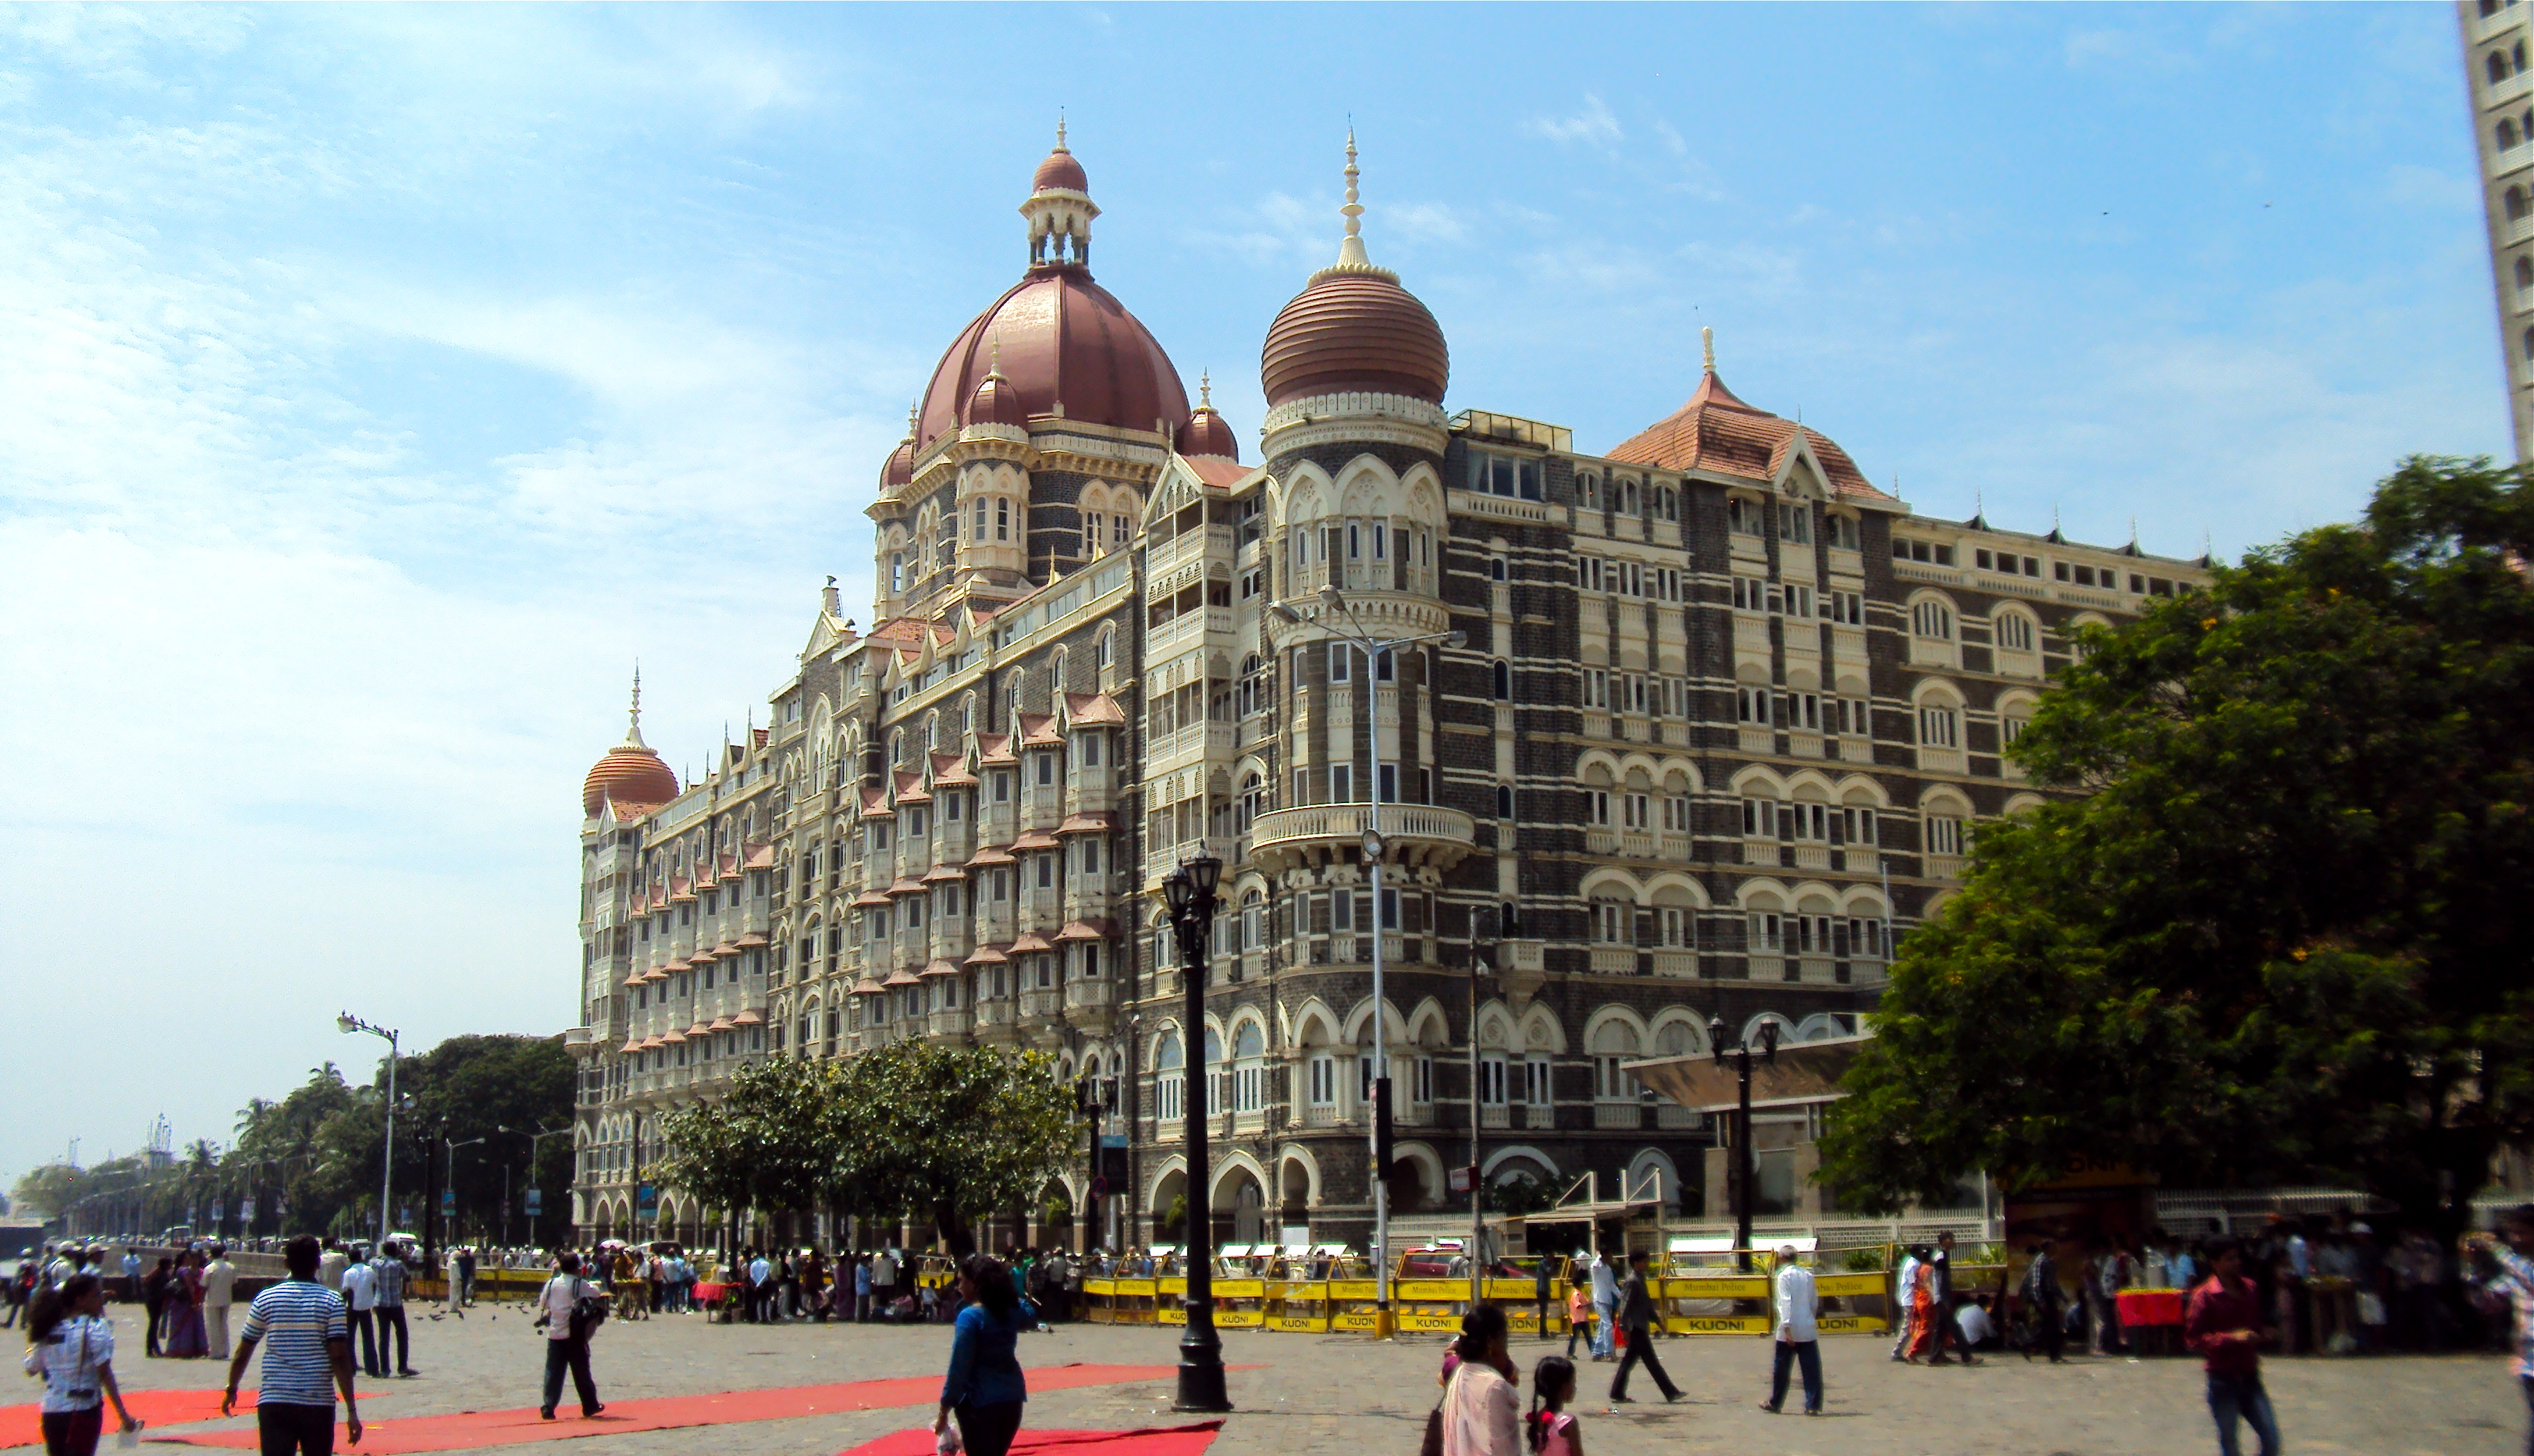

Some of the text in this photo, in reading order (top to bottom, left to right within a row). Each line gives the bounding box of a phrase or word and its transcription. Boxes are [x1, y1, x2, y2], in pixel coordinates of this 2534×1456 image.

[1412, 1286, 1437, 1294] Mumbai
[1684, 1282, 1746, 1291] Mumbai Police
[1836, 1282, 1862, 1291] Police
[1170, 1312, 1186, 1320] KUO
[1416, 1319, 1451, 1327] KUONI
[1508, 1320, 1538, 1329] UONI
[1690, 1321, 1745, 1331] KUONI
[1817, 1320, 1859, 1329] UONI
